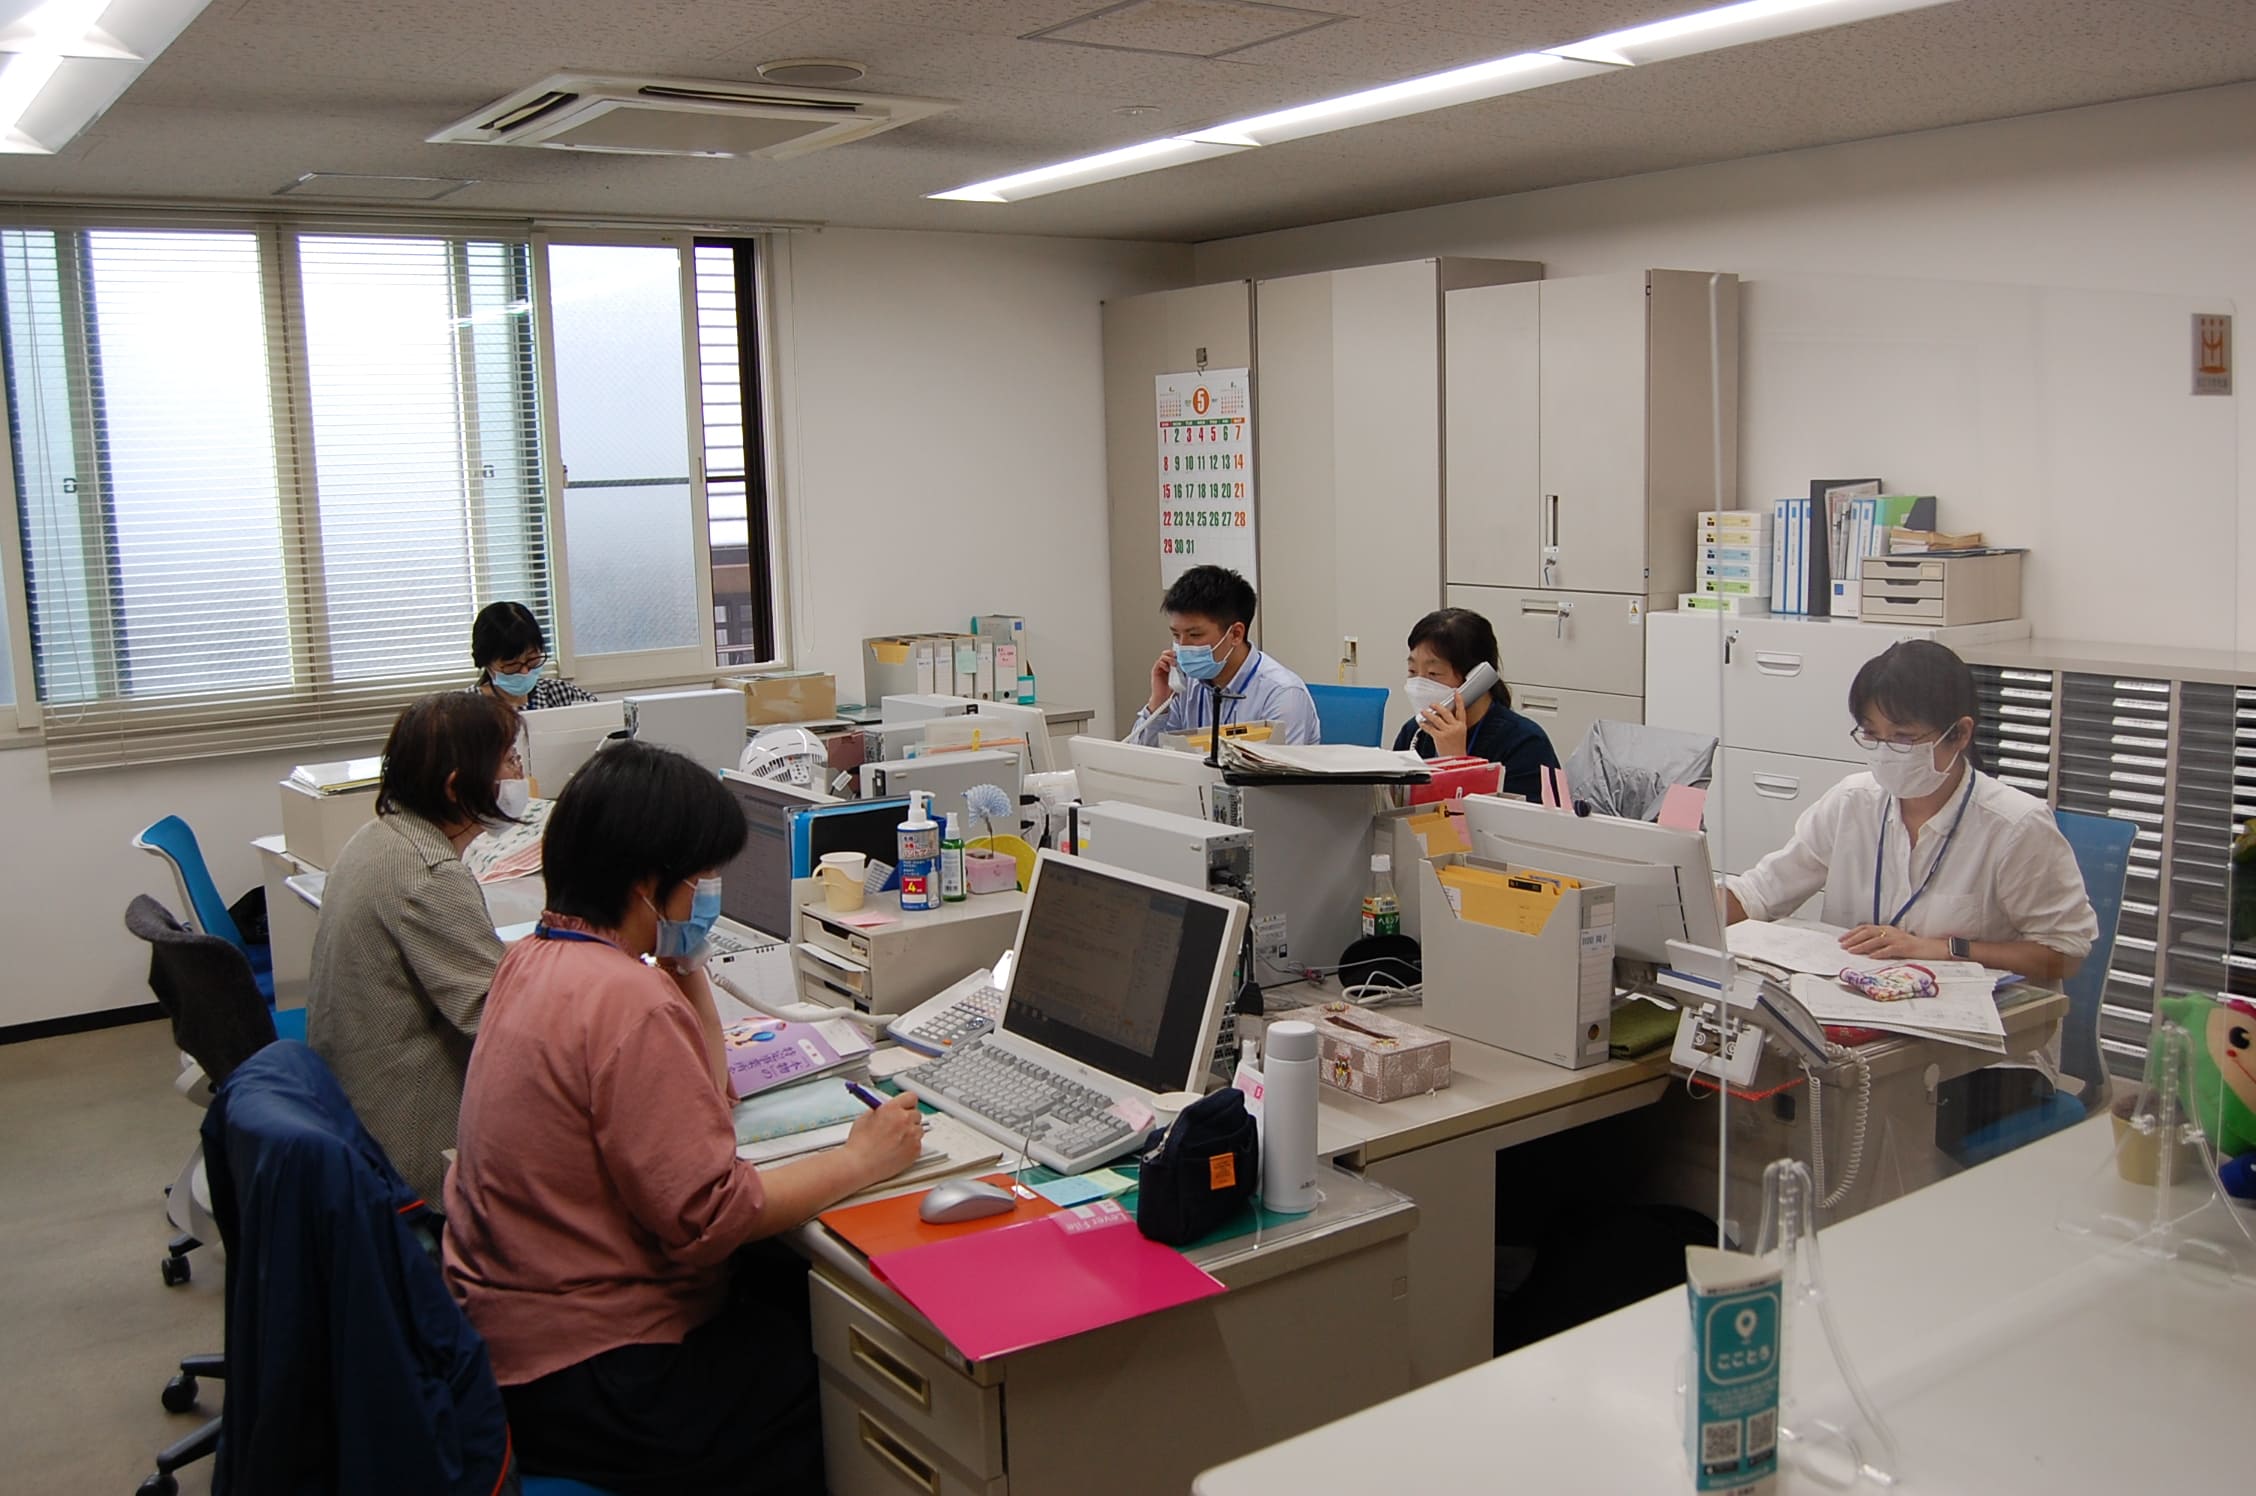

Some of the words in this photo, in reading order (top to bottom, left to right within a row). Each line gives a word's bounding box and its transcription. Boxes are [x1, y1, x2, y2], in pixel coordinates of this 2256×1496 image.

[1196, 390, 1206, 411] 5
[1163, 429, 1167, 444] 1
[1174, 428, 1180, 443] 2
[1186, 427, 1192, 443] 3
[1198, 427, 1204, 442] 4
[1210, 426, 1217, 441] 5
[1223, 426, 1229, 441] 6
[1235, 425, 1241, 441] 7
[1163, 455, 1169, 472] 8
[1174, 455, 1180, 471] 9
[1185, 455, 1194, 471] 10
[1197, 455, 1206, 471] 11
[1209, 455, 1218, 470] 12
[1221, 454, 1231, 470] 13
[1233, 454, 1244, 470] 14
[1162, 483, 1171, 500] 15
[1173, 483, 1183, 499] 16
[1185, 483, 1195, 499] 17
[1197, 483, 1207, 499] 18
[1209, 483, 1219, 499] 19
[1221, 482, 1232, 499] 20
[1234, 482, 1245, 498] 21
[1163, 511, 1172, 527] 22
[1173, 511, 1184, 527] 23
[1185, 511, 1195, 527] 24
[1197, 511, 1207, 527] 25
[1209, 511, 1220, 527] 26
[1221, 511, 1232, 527] 27
[1234, 511, 1246, 527] 28
[1163, 538, 1173, 554] 29
[1174, 538, 1184, 554] 30
[1185, 539, 1195, 554] 31
[907, 881, 917, 893] 4
